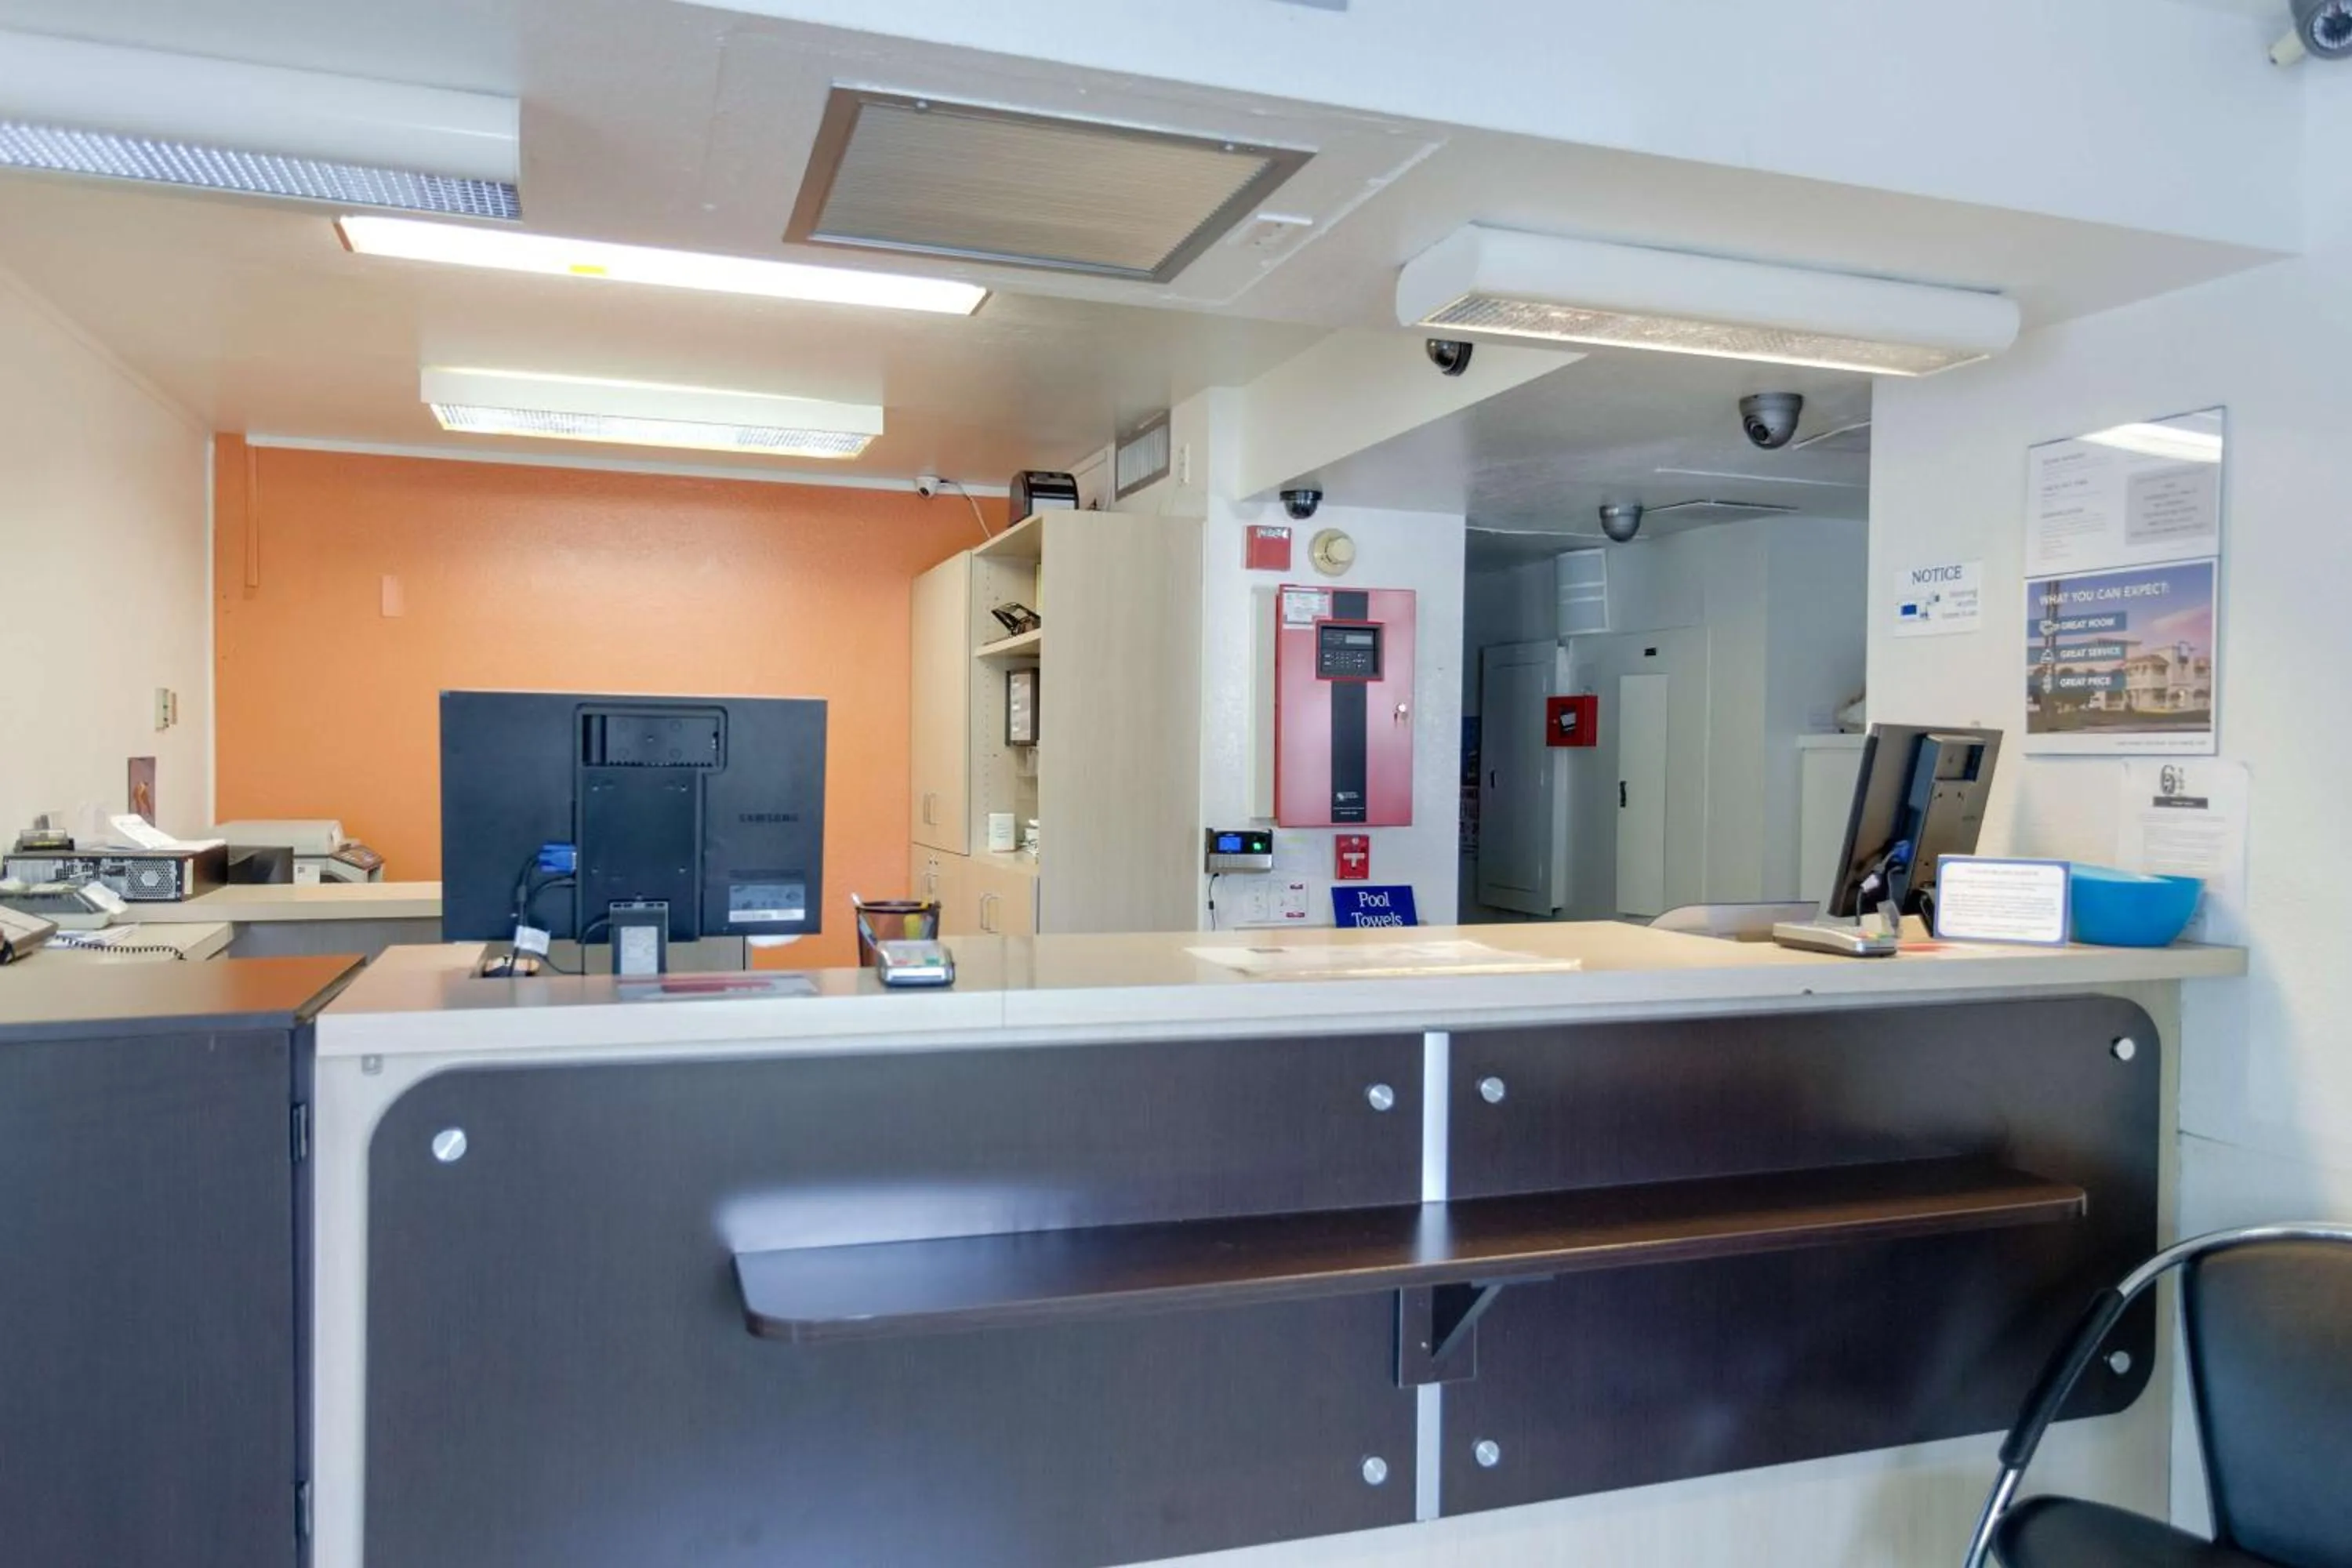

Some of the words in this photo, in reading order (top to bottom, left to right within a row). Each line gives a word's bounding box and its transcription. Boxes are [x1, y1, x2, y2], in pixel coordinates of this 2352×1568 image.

[1911, 565, 1962, 585] NOTICE
[2040, 593, 2068, 605] WHAT
[2072, 592, 2094, 602] YOU
[2096, 588, 2121, 600] CAN
[2060, 648, 2085, 659] GREAT
[2088, 647, 2121, 657] SERVICE
[2060, 677, 2085, 688] GREAT
[2088, 676, 2111, 687] PRICE
[1358, 891, 1391, 907] Pool
[1351, 911, 1403, 927] Towels
